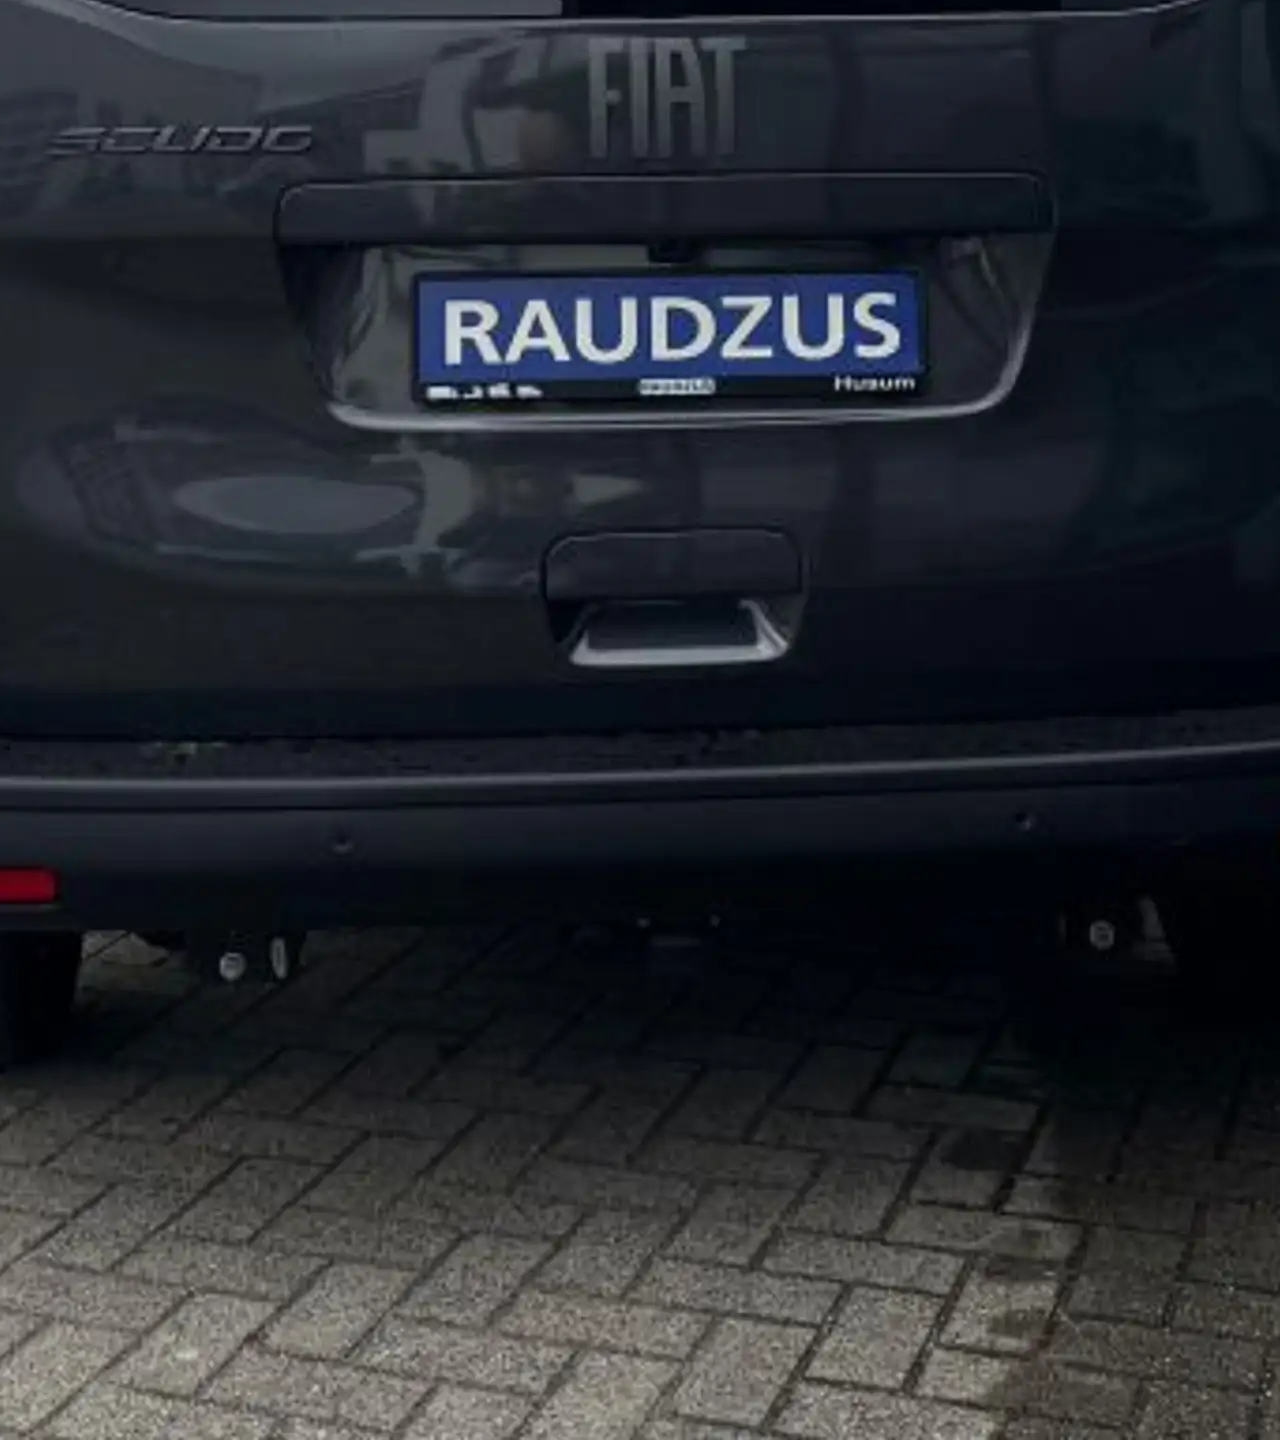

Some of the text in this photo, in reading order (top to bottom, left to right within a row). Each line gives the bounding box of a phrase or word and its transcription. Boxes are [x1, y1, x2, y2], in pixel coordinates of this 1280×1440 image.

[587, 36, 748, 159] FIAT
[44, 124, 314, 156] SCUDO
[443, 290, 902, 366] RAUDZUS
[833, 373, 917, 394] Husum
